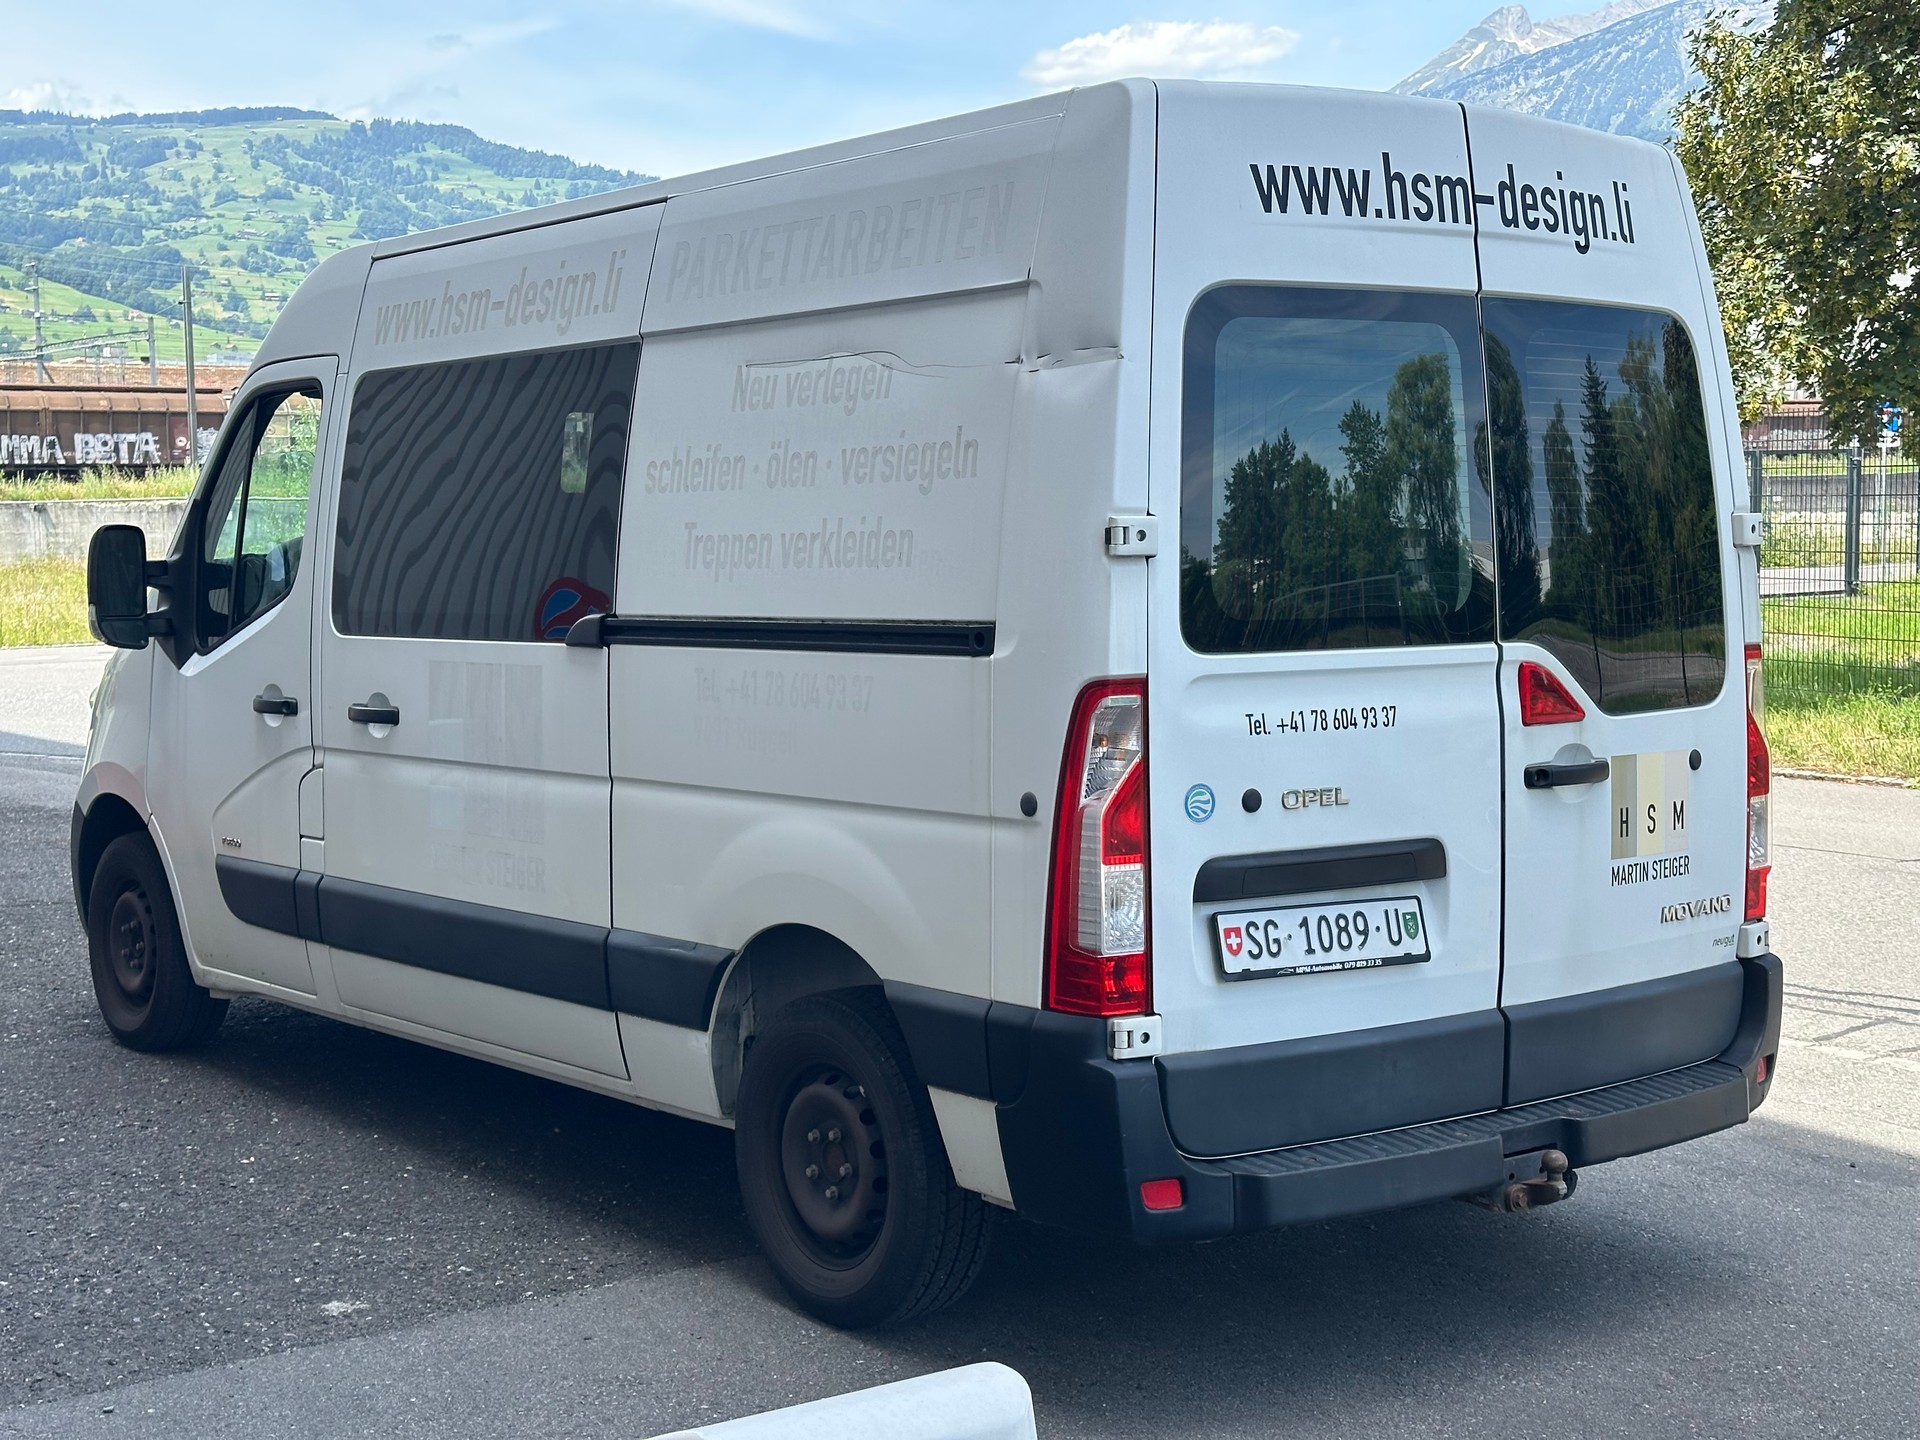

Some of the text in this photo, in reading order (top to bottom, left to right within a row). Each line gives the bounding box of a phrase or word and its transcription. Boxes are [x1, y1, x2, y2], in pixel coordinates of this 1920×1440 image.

[1249, 151, 1636, 255] www.hsm-design.li
[666, 181, 1015, 304] PARKETTARBEITEN
[374, 249, 626, 346] www.hsm-design.li
[731, 359, 894, 417] Neu verlegen
[644, 425, 979, 496] schleifen ölen versiegeln
[684, 516, 914, 582] Treppen verkleiden
[1245, 705, 1397, 736] Tel. +41 78 604 93 37
[1281, 786, 1350, 810] OPEL
[1611, 855, 1690, 887] MARTIN STEIGER
[1660, 894, 1732, 923] MOVANO
